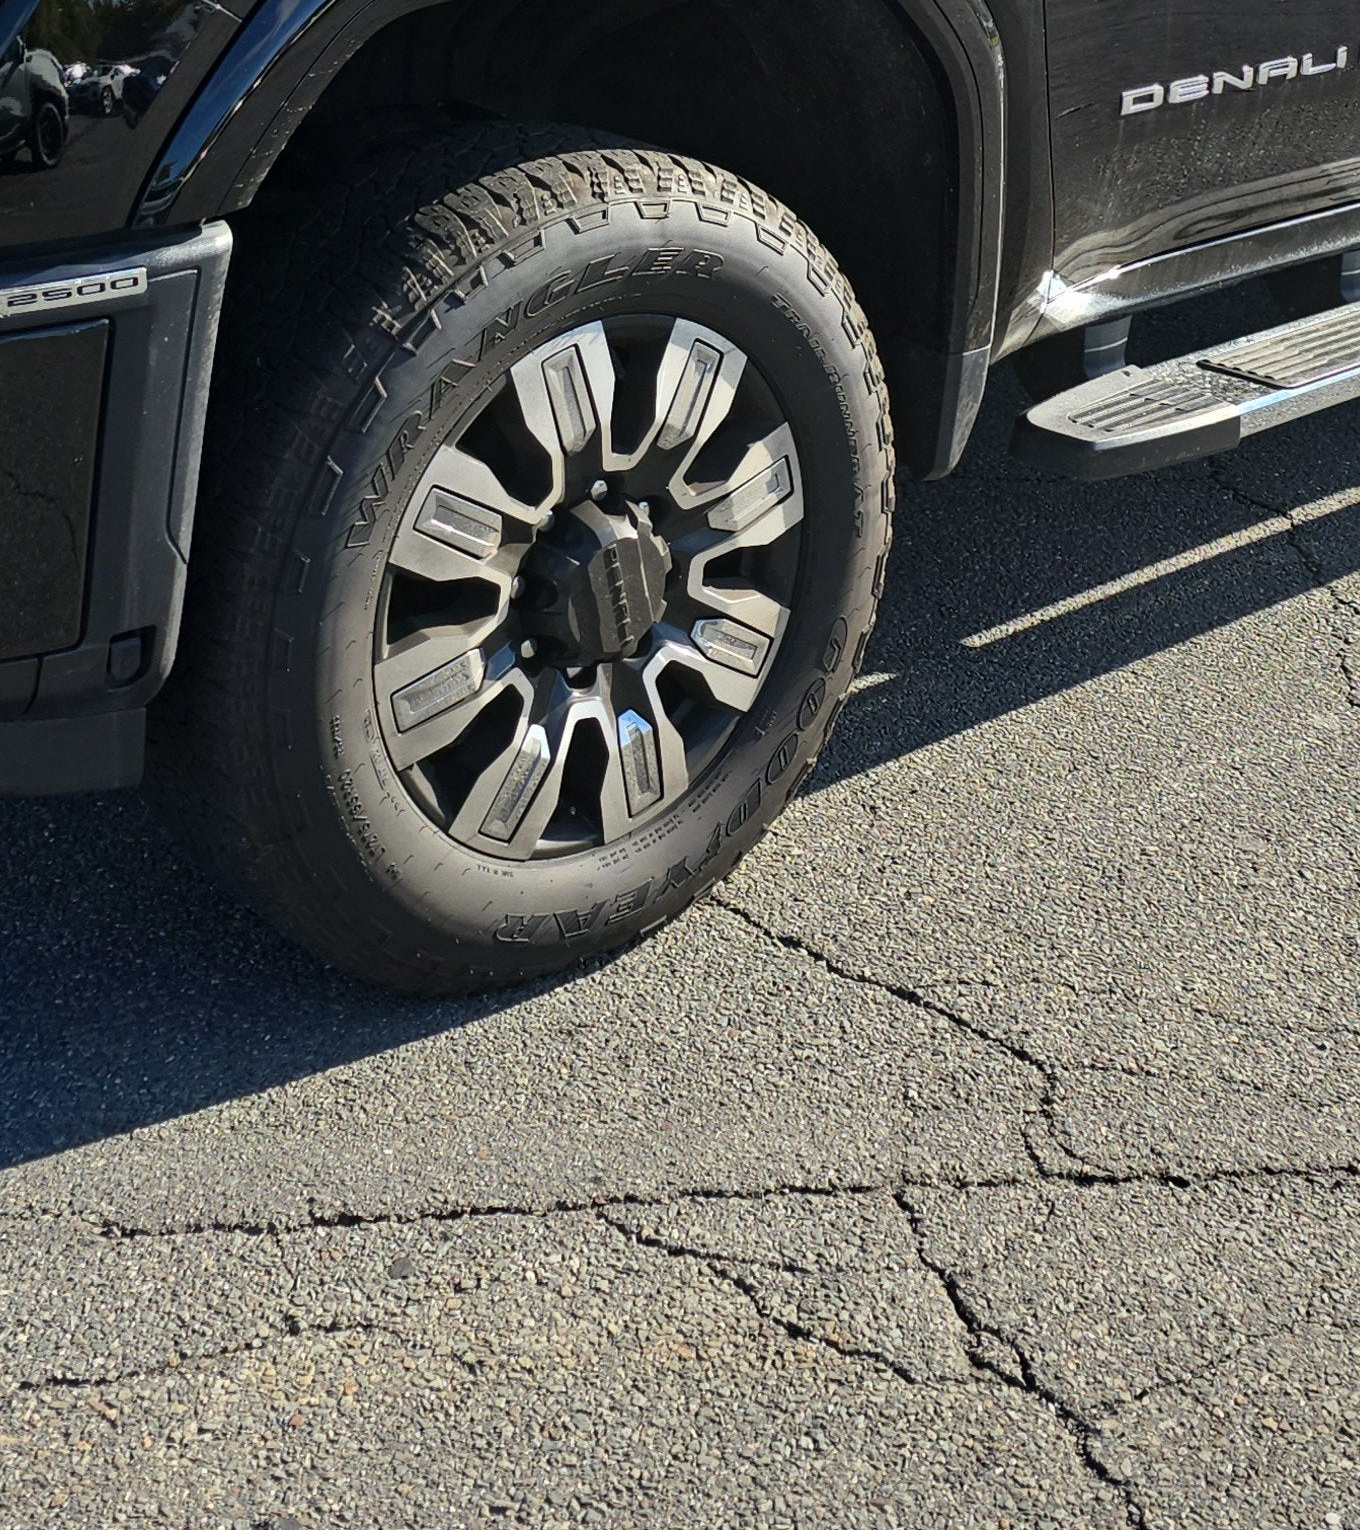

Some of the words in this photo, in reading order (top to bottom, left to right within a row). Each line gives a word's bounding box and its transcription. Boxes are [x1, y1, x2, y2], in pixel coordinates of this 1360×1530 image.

[1120, 46, 1348, 116] DENALI
[6, 275, 139, 308] 2500
[345, 245, 727, 550] WRANGLER
[493, 615, 848, 944] GOODYEAR
